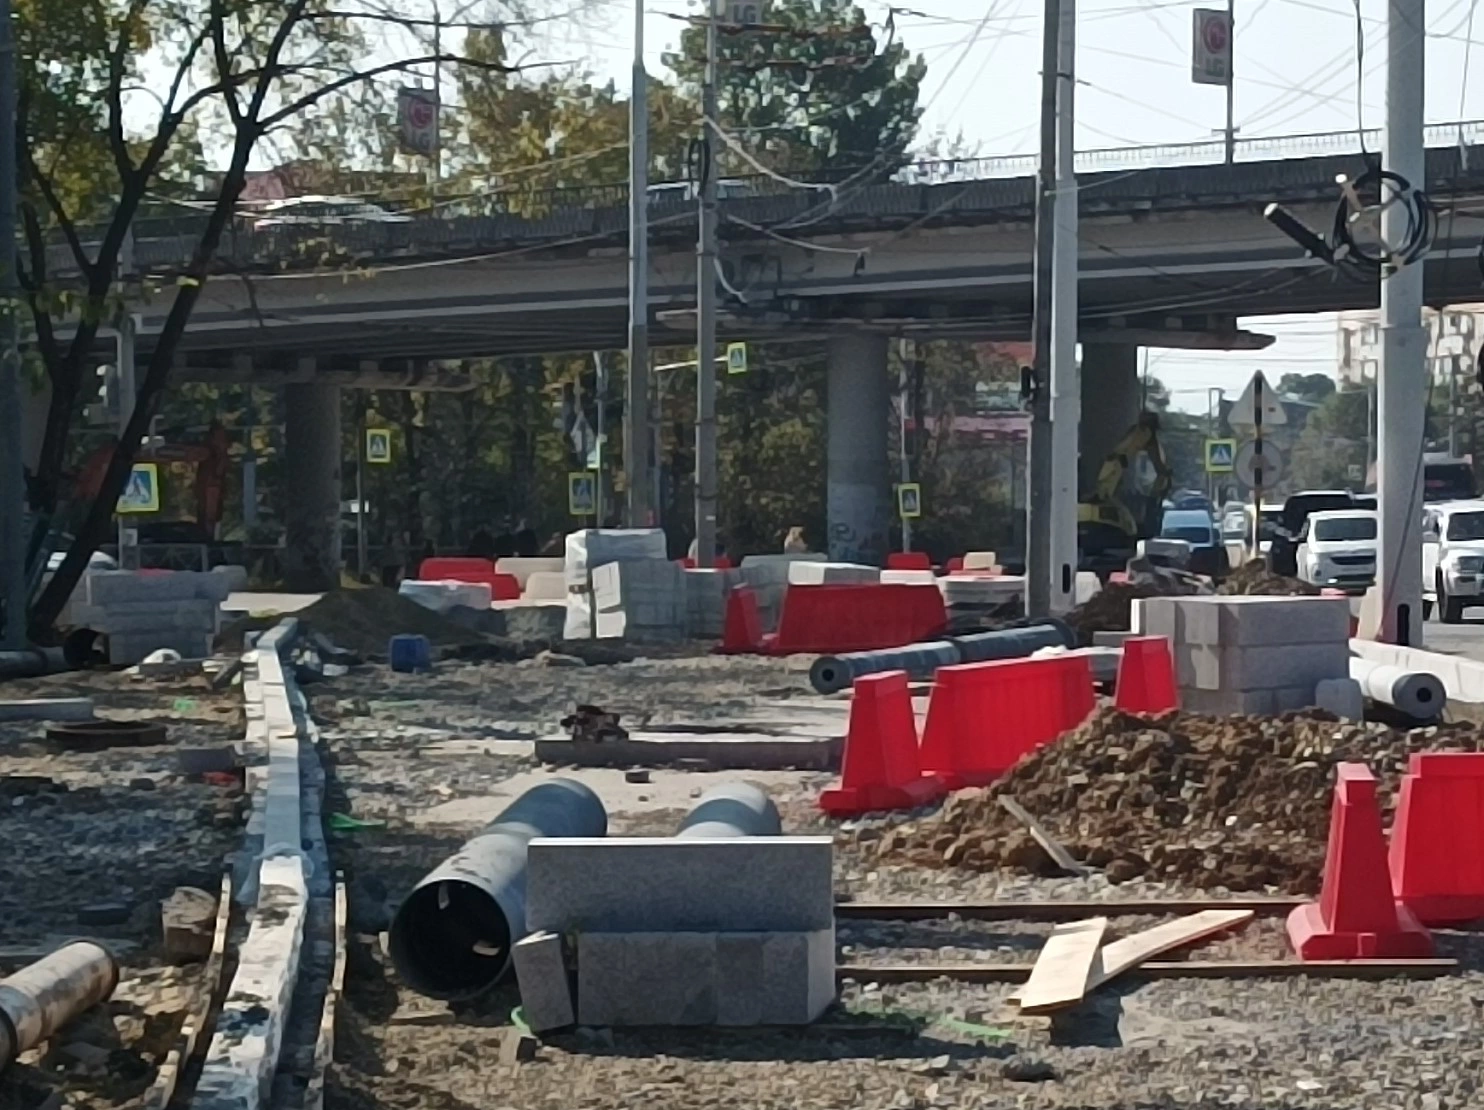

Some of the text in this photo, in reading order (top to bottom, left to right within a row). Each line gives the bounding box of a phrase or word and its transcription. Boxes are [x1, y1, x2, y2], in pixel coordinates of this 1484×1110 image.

[733, 4, 757, 24] LG
[1205, 57, 1225, 78] LG
[411, 131, 432, 151] LG
